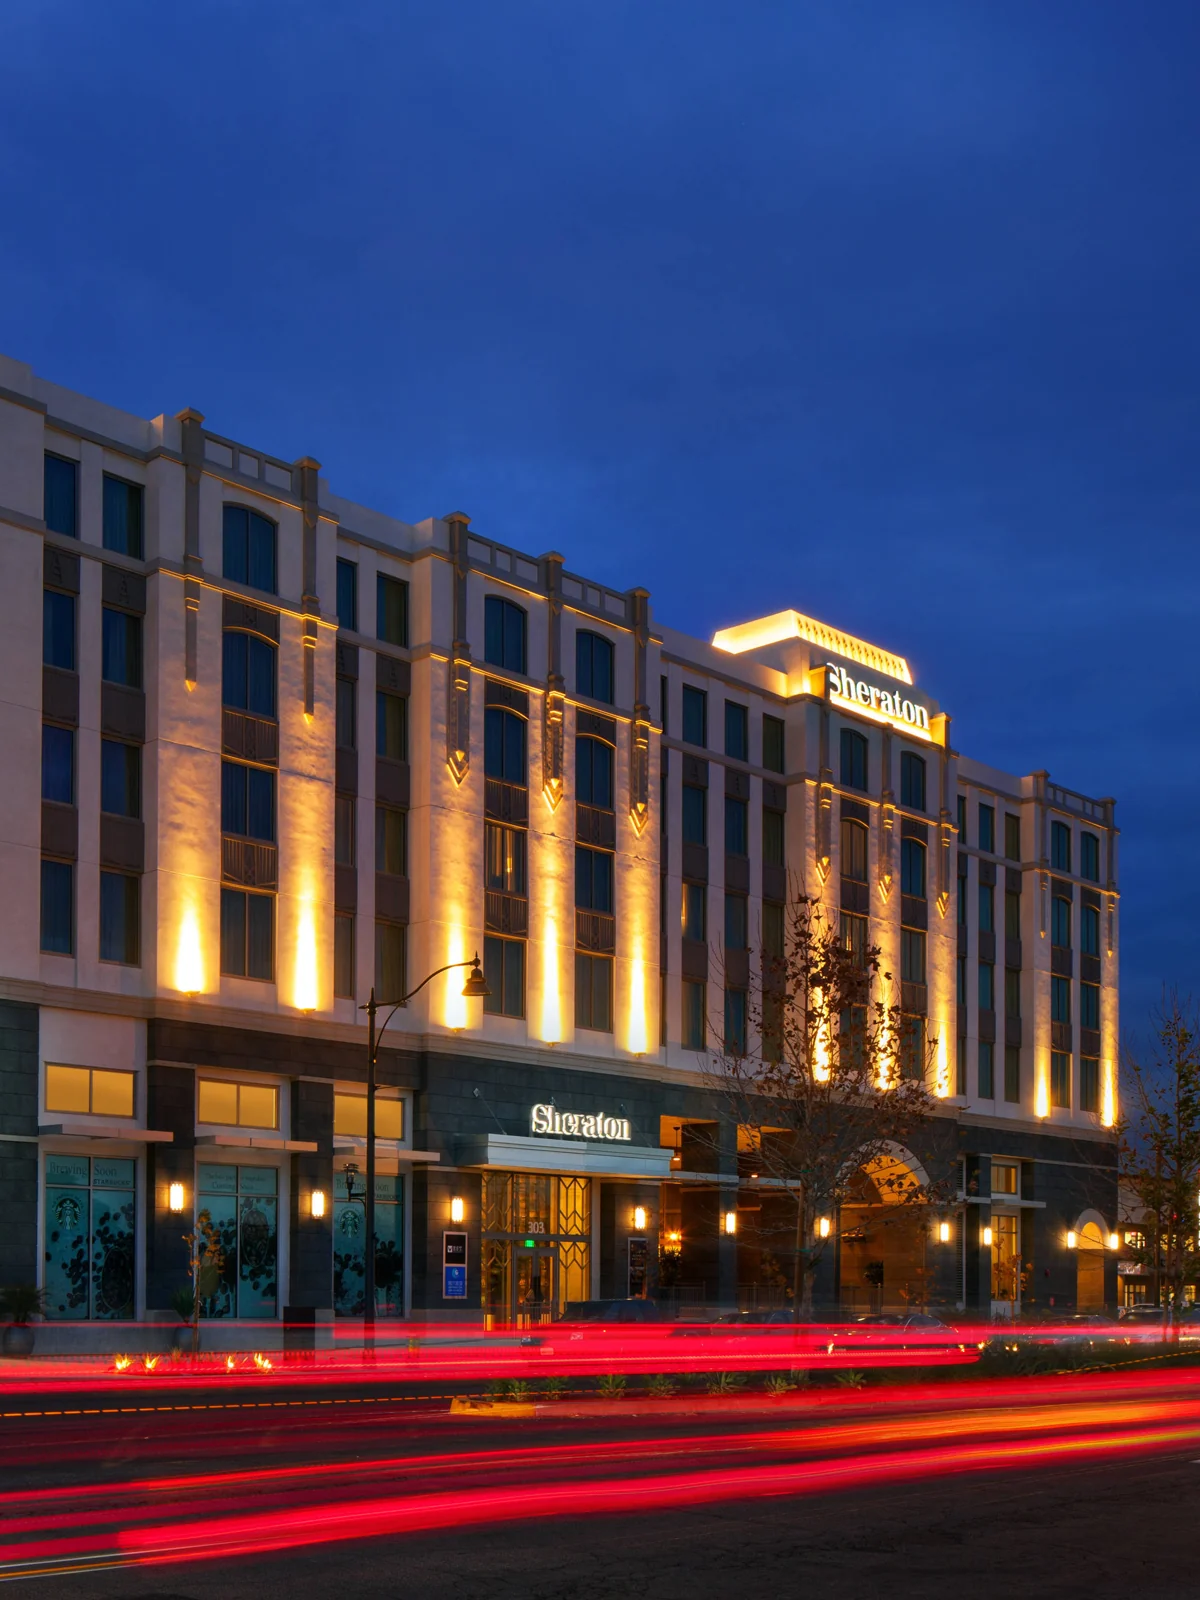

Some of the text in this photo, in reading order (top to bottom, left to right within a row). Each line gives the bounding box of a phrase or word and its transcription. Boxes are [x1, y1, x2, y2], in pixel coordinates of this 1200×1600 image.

[827, 662, 930, 730] Sheraton
[531, 1104, 632, 1141] Sheraton
[50, 1161, 117, 1178] Brewing Soon
[336, 1178, 390, 1192] Bring oon
[528, 1221, 545, 1234] 303
